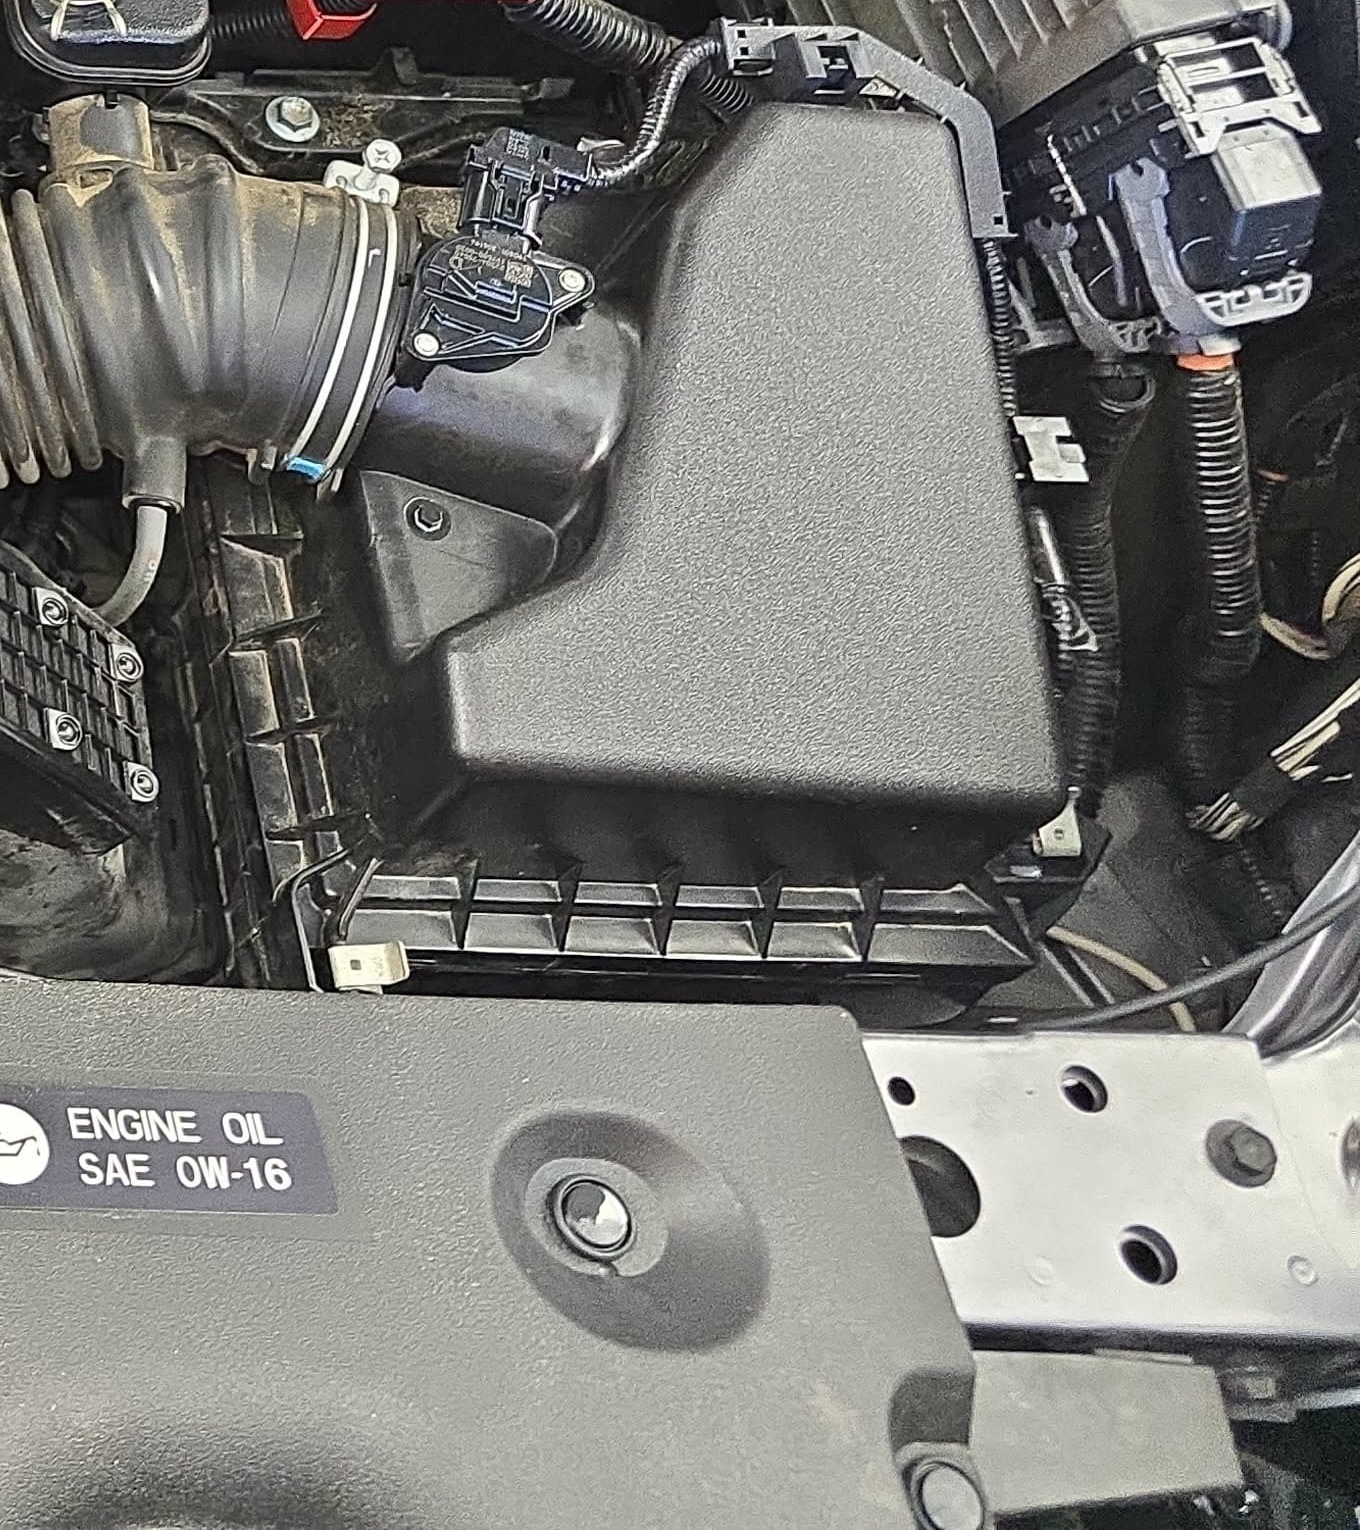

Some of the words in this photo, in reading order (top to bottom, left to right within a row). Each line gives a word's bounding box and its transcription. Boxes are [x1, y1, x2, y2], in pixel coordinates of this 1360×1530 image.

[66, 1106, 203, 1144] ENGINE
[221, 1111, 285, 1146] OIL
[78, 1151, 156, 1188] SAE
[175, 1154, 293, 1192] 0W-16
